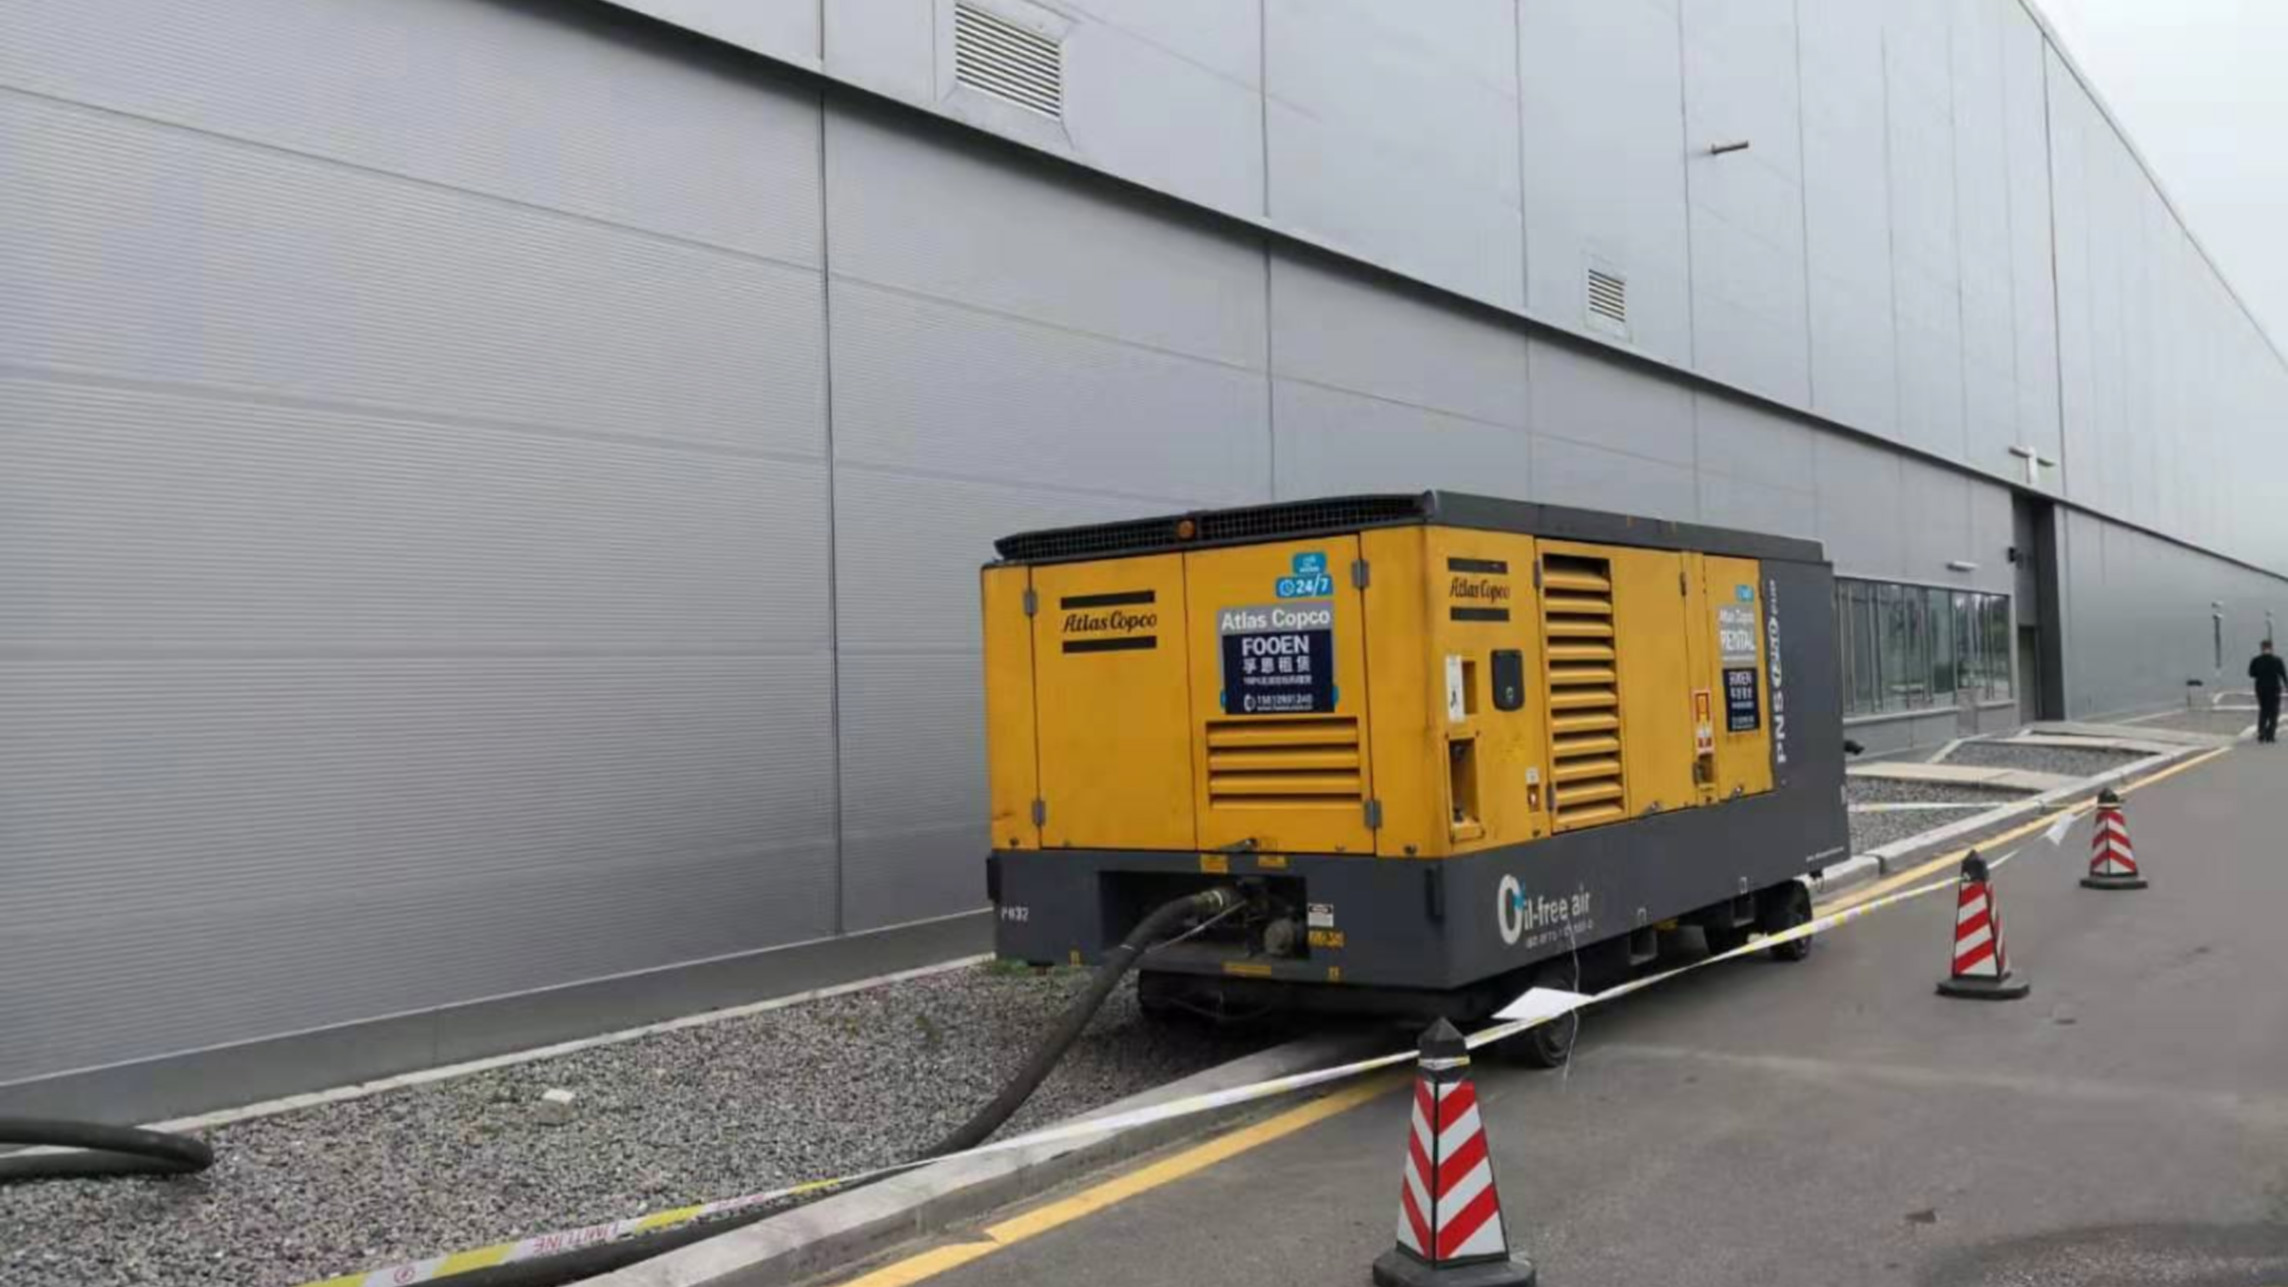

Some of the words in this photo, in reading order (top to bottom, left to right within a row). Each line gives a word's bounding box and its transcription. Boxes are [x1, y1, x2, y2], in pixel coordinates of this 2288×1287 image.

[1296, 573, 1329, 596] 24/7
[1064, 612, 1108, 633] Atlas
[1110, 609, 1157, 633] Copco
[1221, 611, 1267, 631] Atlas
[1272, 608, 1331, 630] Copco
[1242, 635, 1309, 656] FOOEN
[1572, 886, 1589, 916] air
